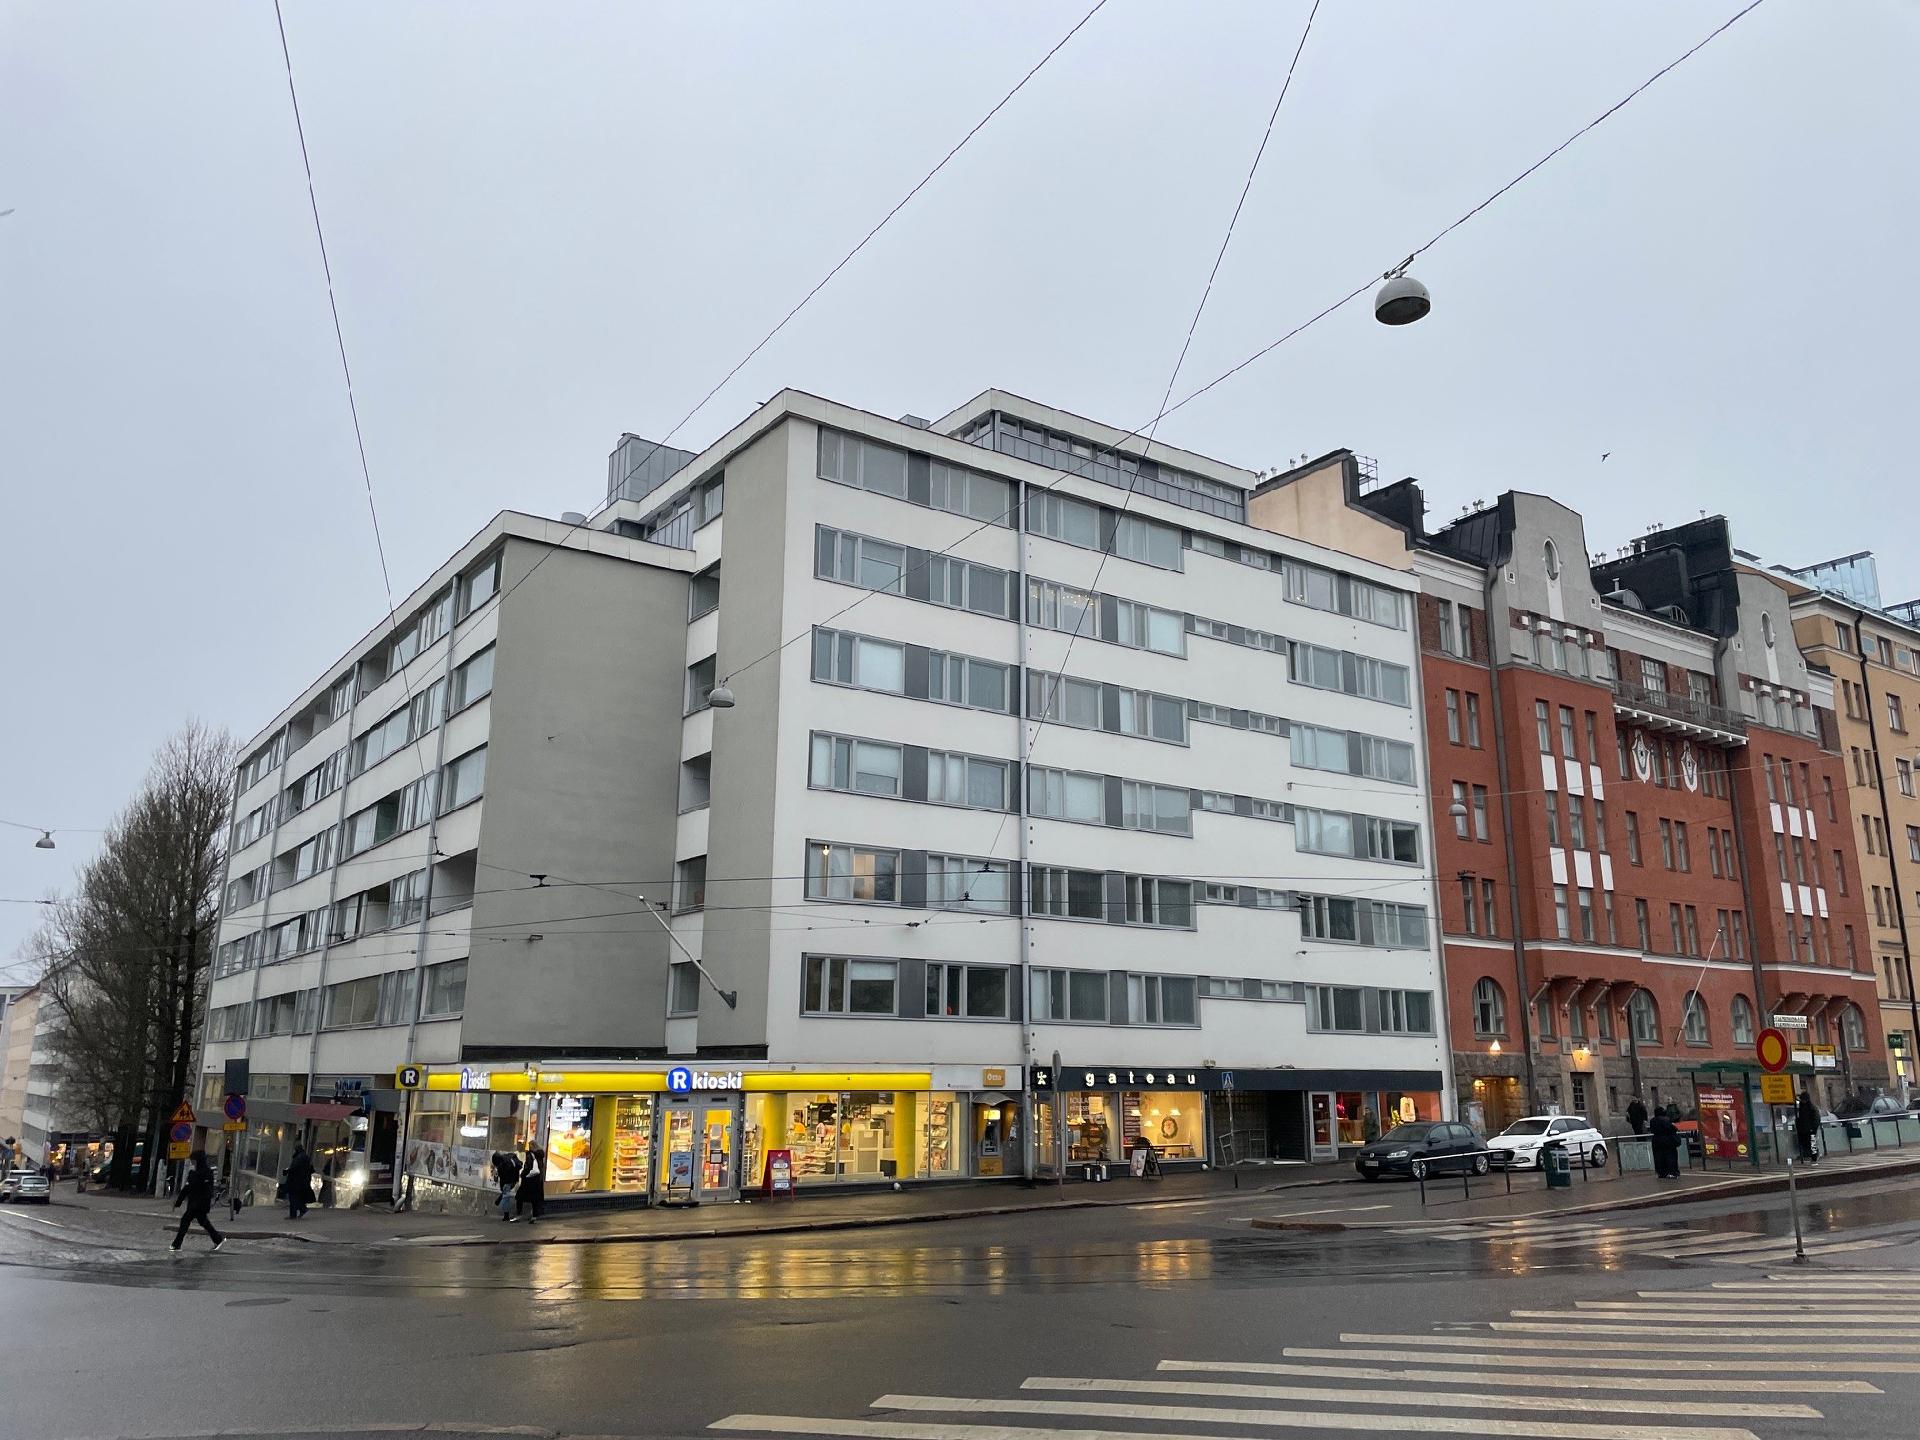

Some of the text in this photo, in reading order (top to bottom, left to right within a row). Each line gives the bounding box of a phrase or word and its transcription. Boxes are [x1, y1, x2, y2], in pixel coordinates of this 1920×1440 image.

[404, 1072, 416, 1084] R
[672, 1071, 743, 1090] R kioski
[1085, 1071, 1196, 1087] gateau
